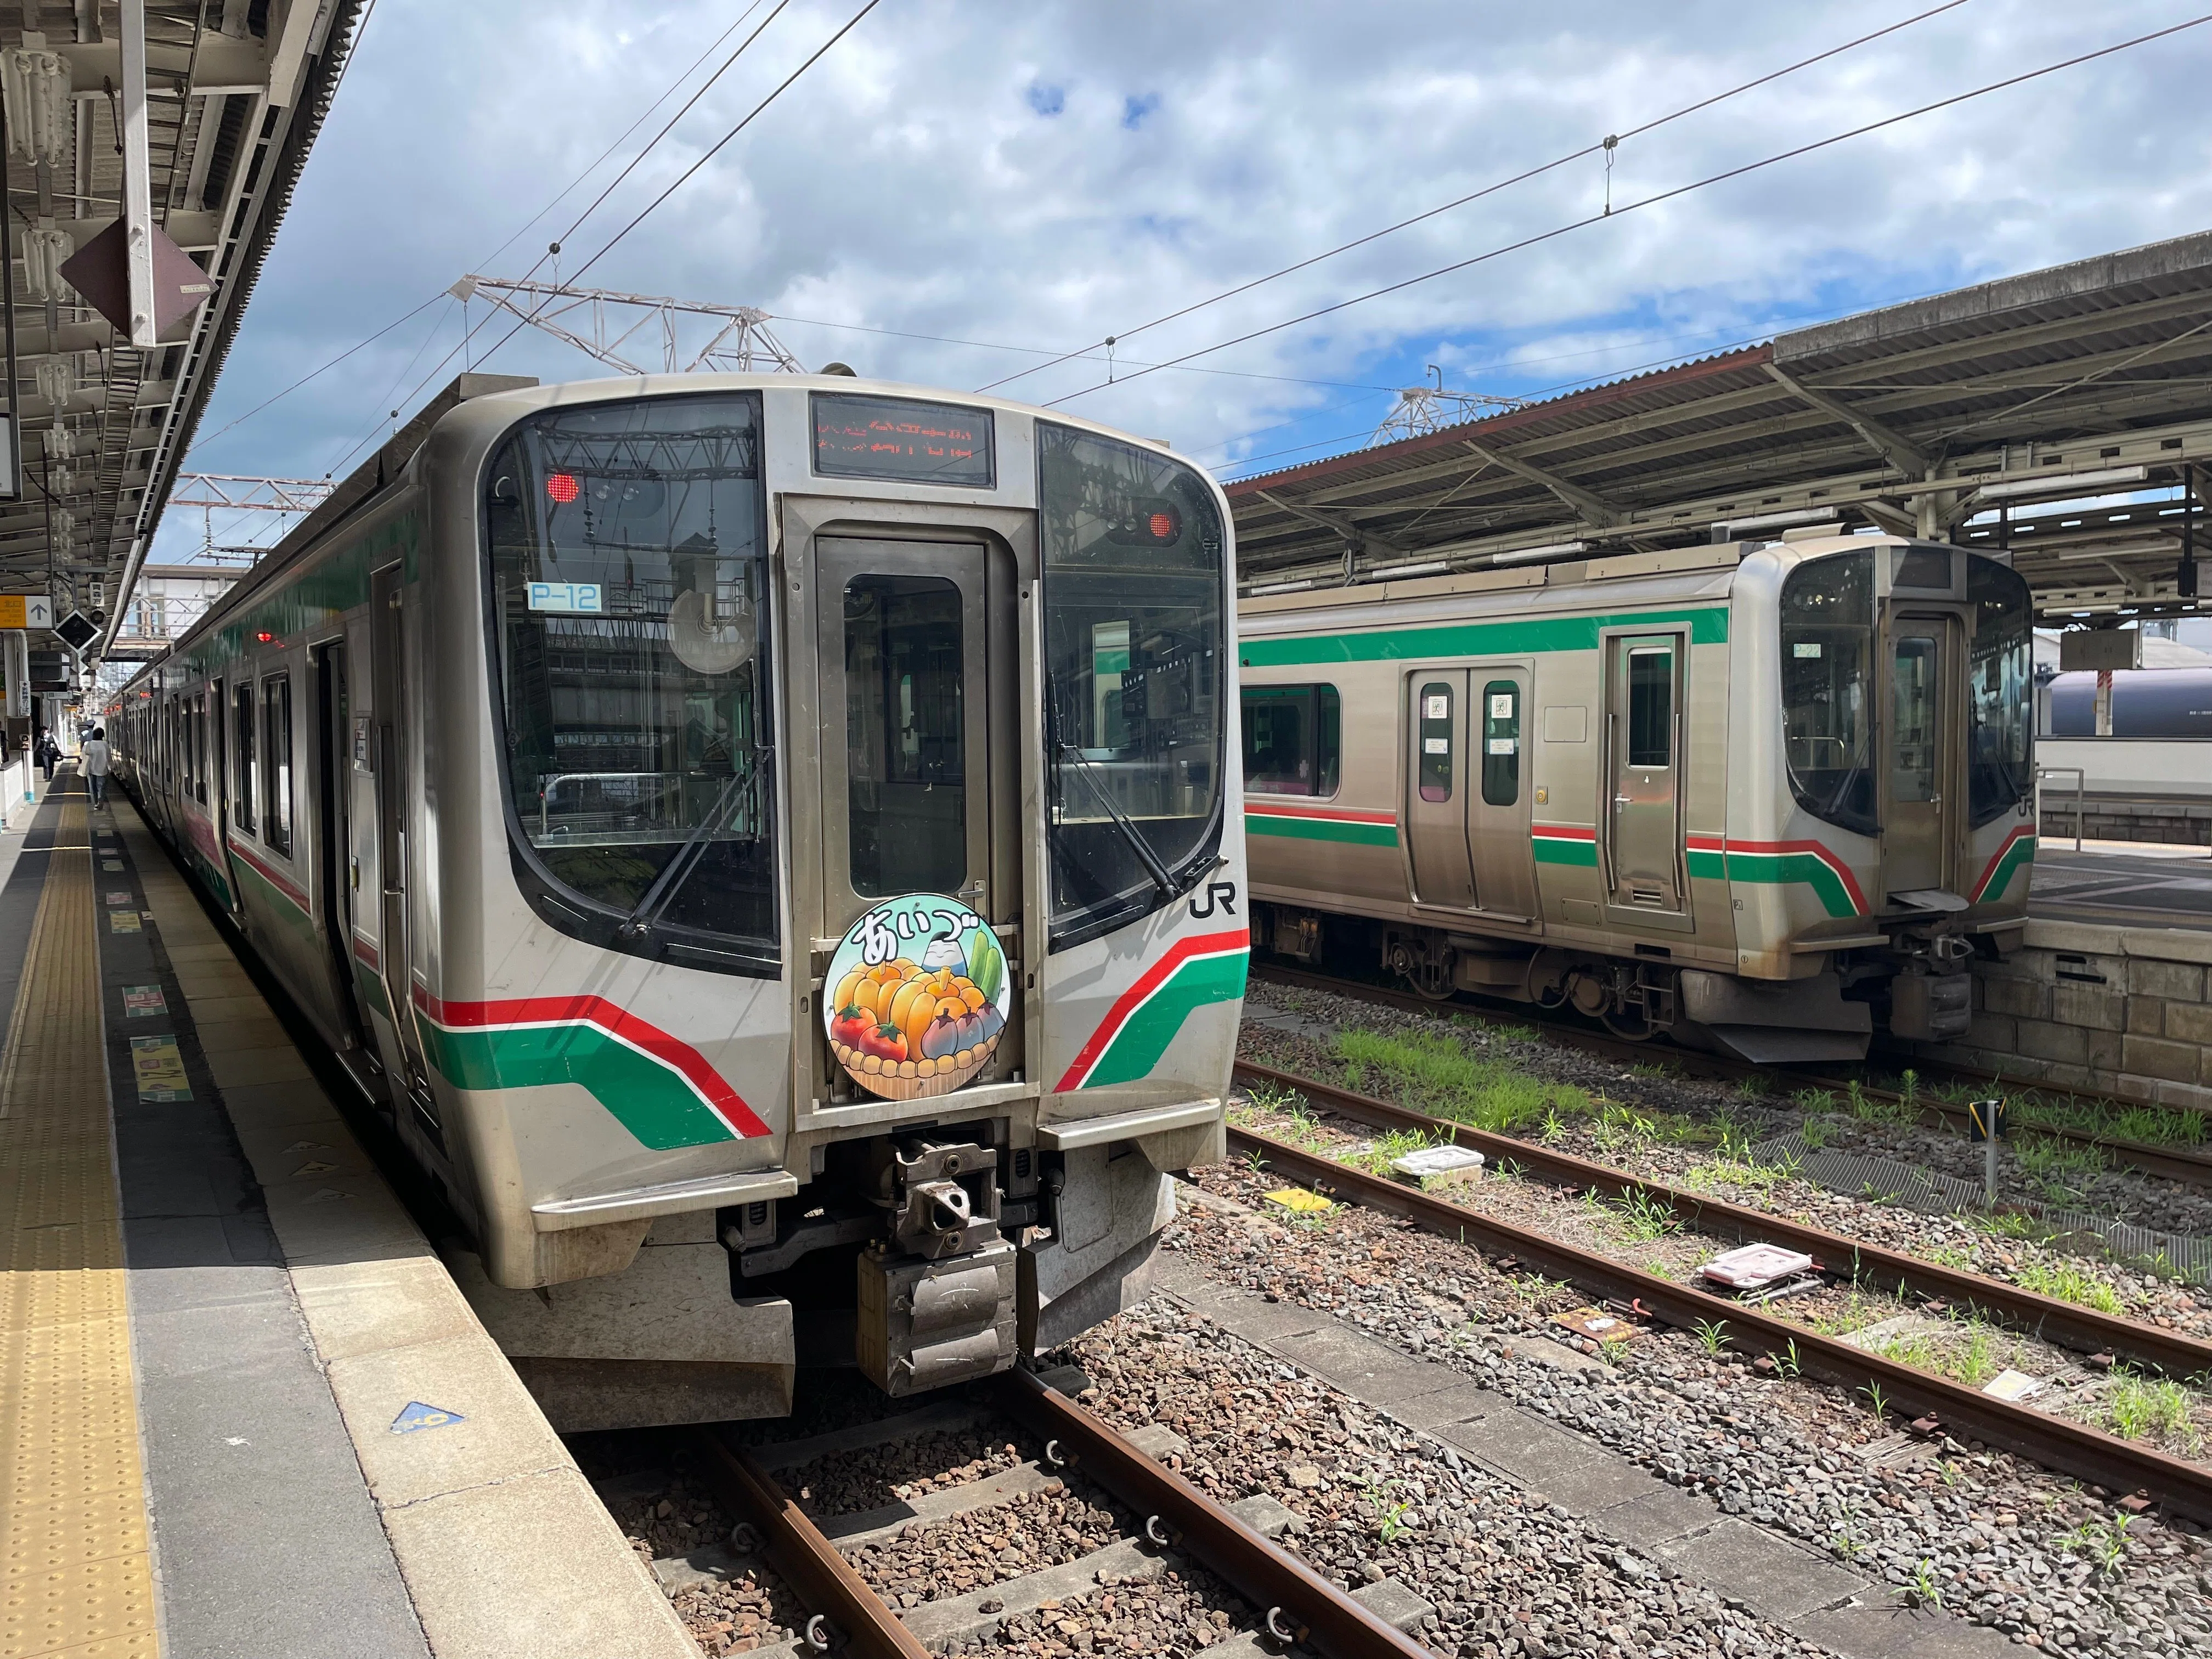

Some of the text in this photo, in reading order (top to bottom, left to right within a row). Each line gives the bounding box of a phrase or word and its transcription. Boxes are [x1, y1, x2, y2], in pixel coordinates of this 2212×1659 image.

[532, 584, 597, 610] P-12
[1795, 645, 1820, 656] P-22
[2018, 798, 2034, 817] JR
[1189, 882, 1236, 919] JR
[851, 909, 980, 966] あいづ
